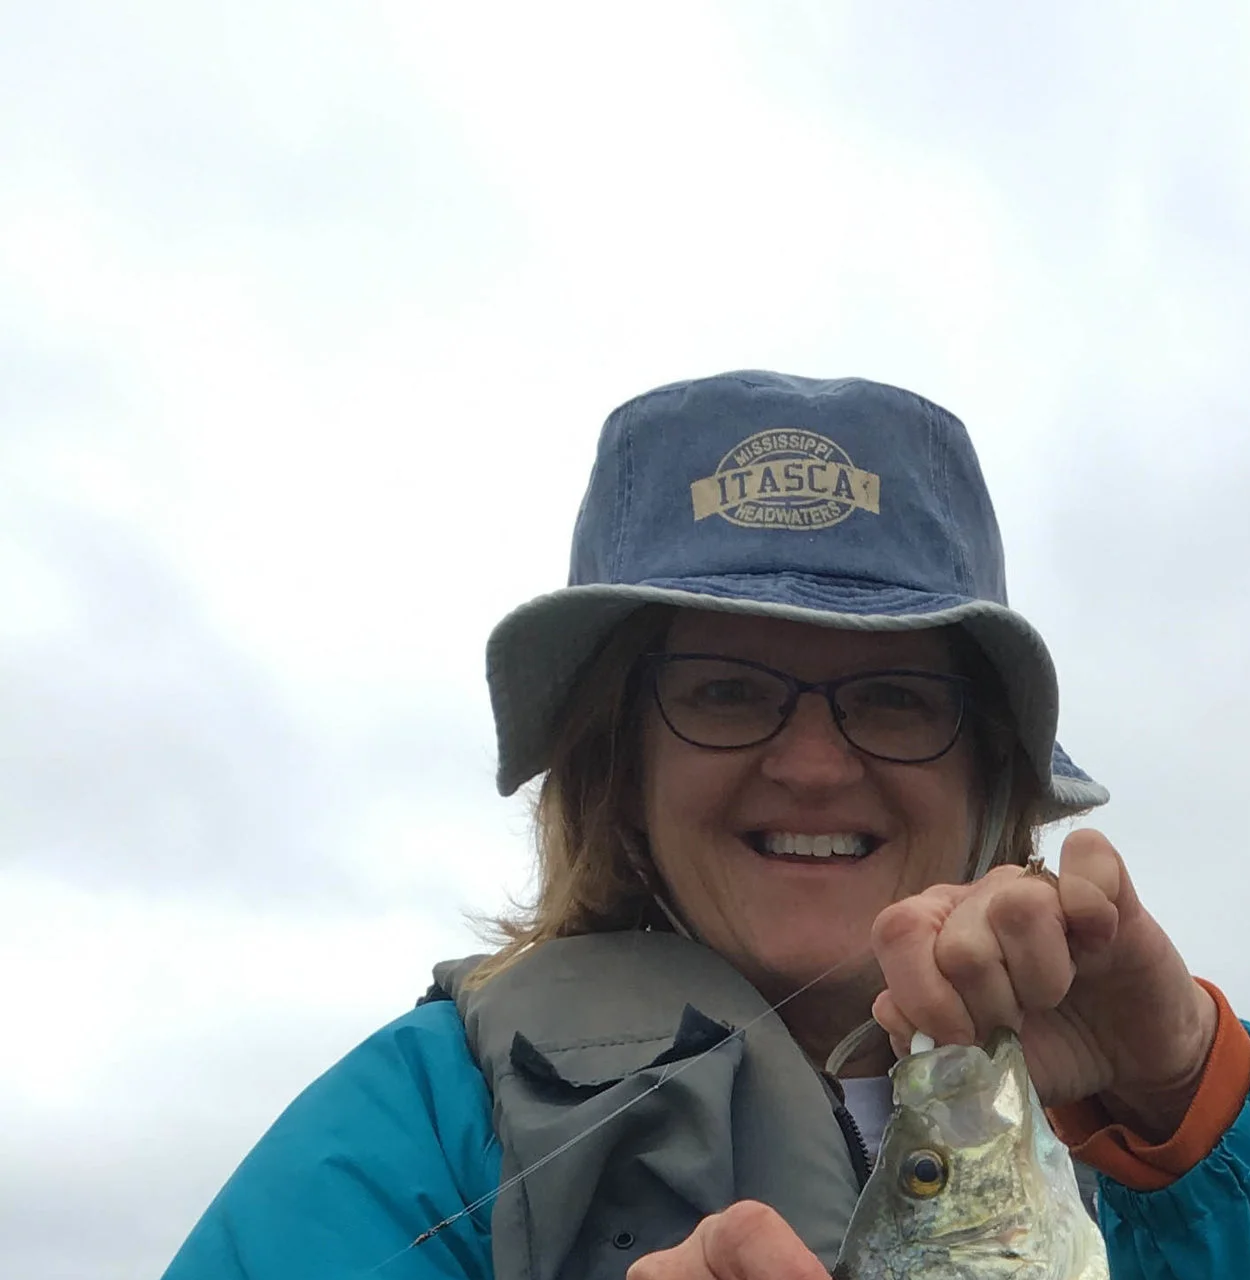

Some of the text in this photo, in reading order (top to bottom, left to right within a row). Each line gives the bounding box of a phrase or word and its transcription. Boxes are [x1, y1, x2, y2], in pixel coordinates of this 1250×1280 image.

[733, 433, 834, 467] MISSISSIPPI
[717, 463, 856, 506] ITASCA
[735, 501, 841, 525] HEADWATERS
